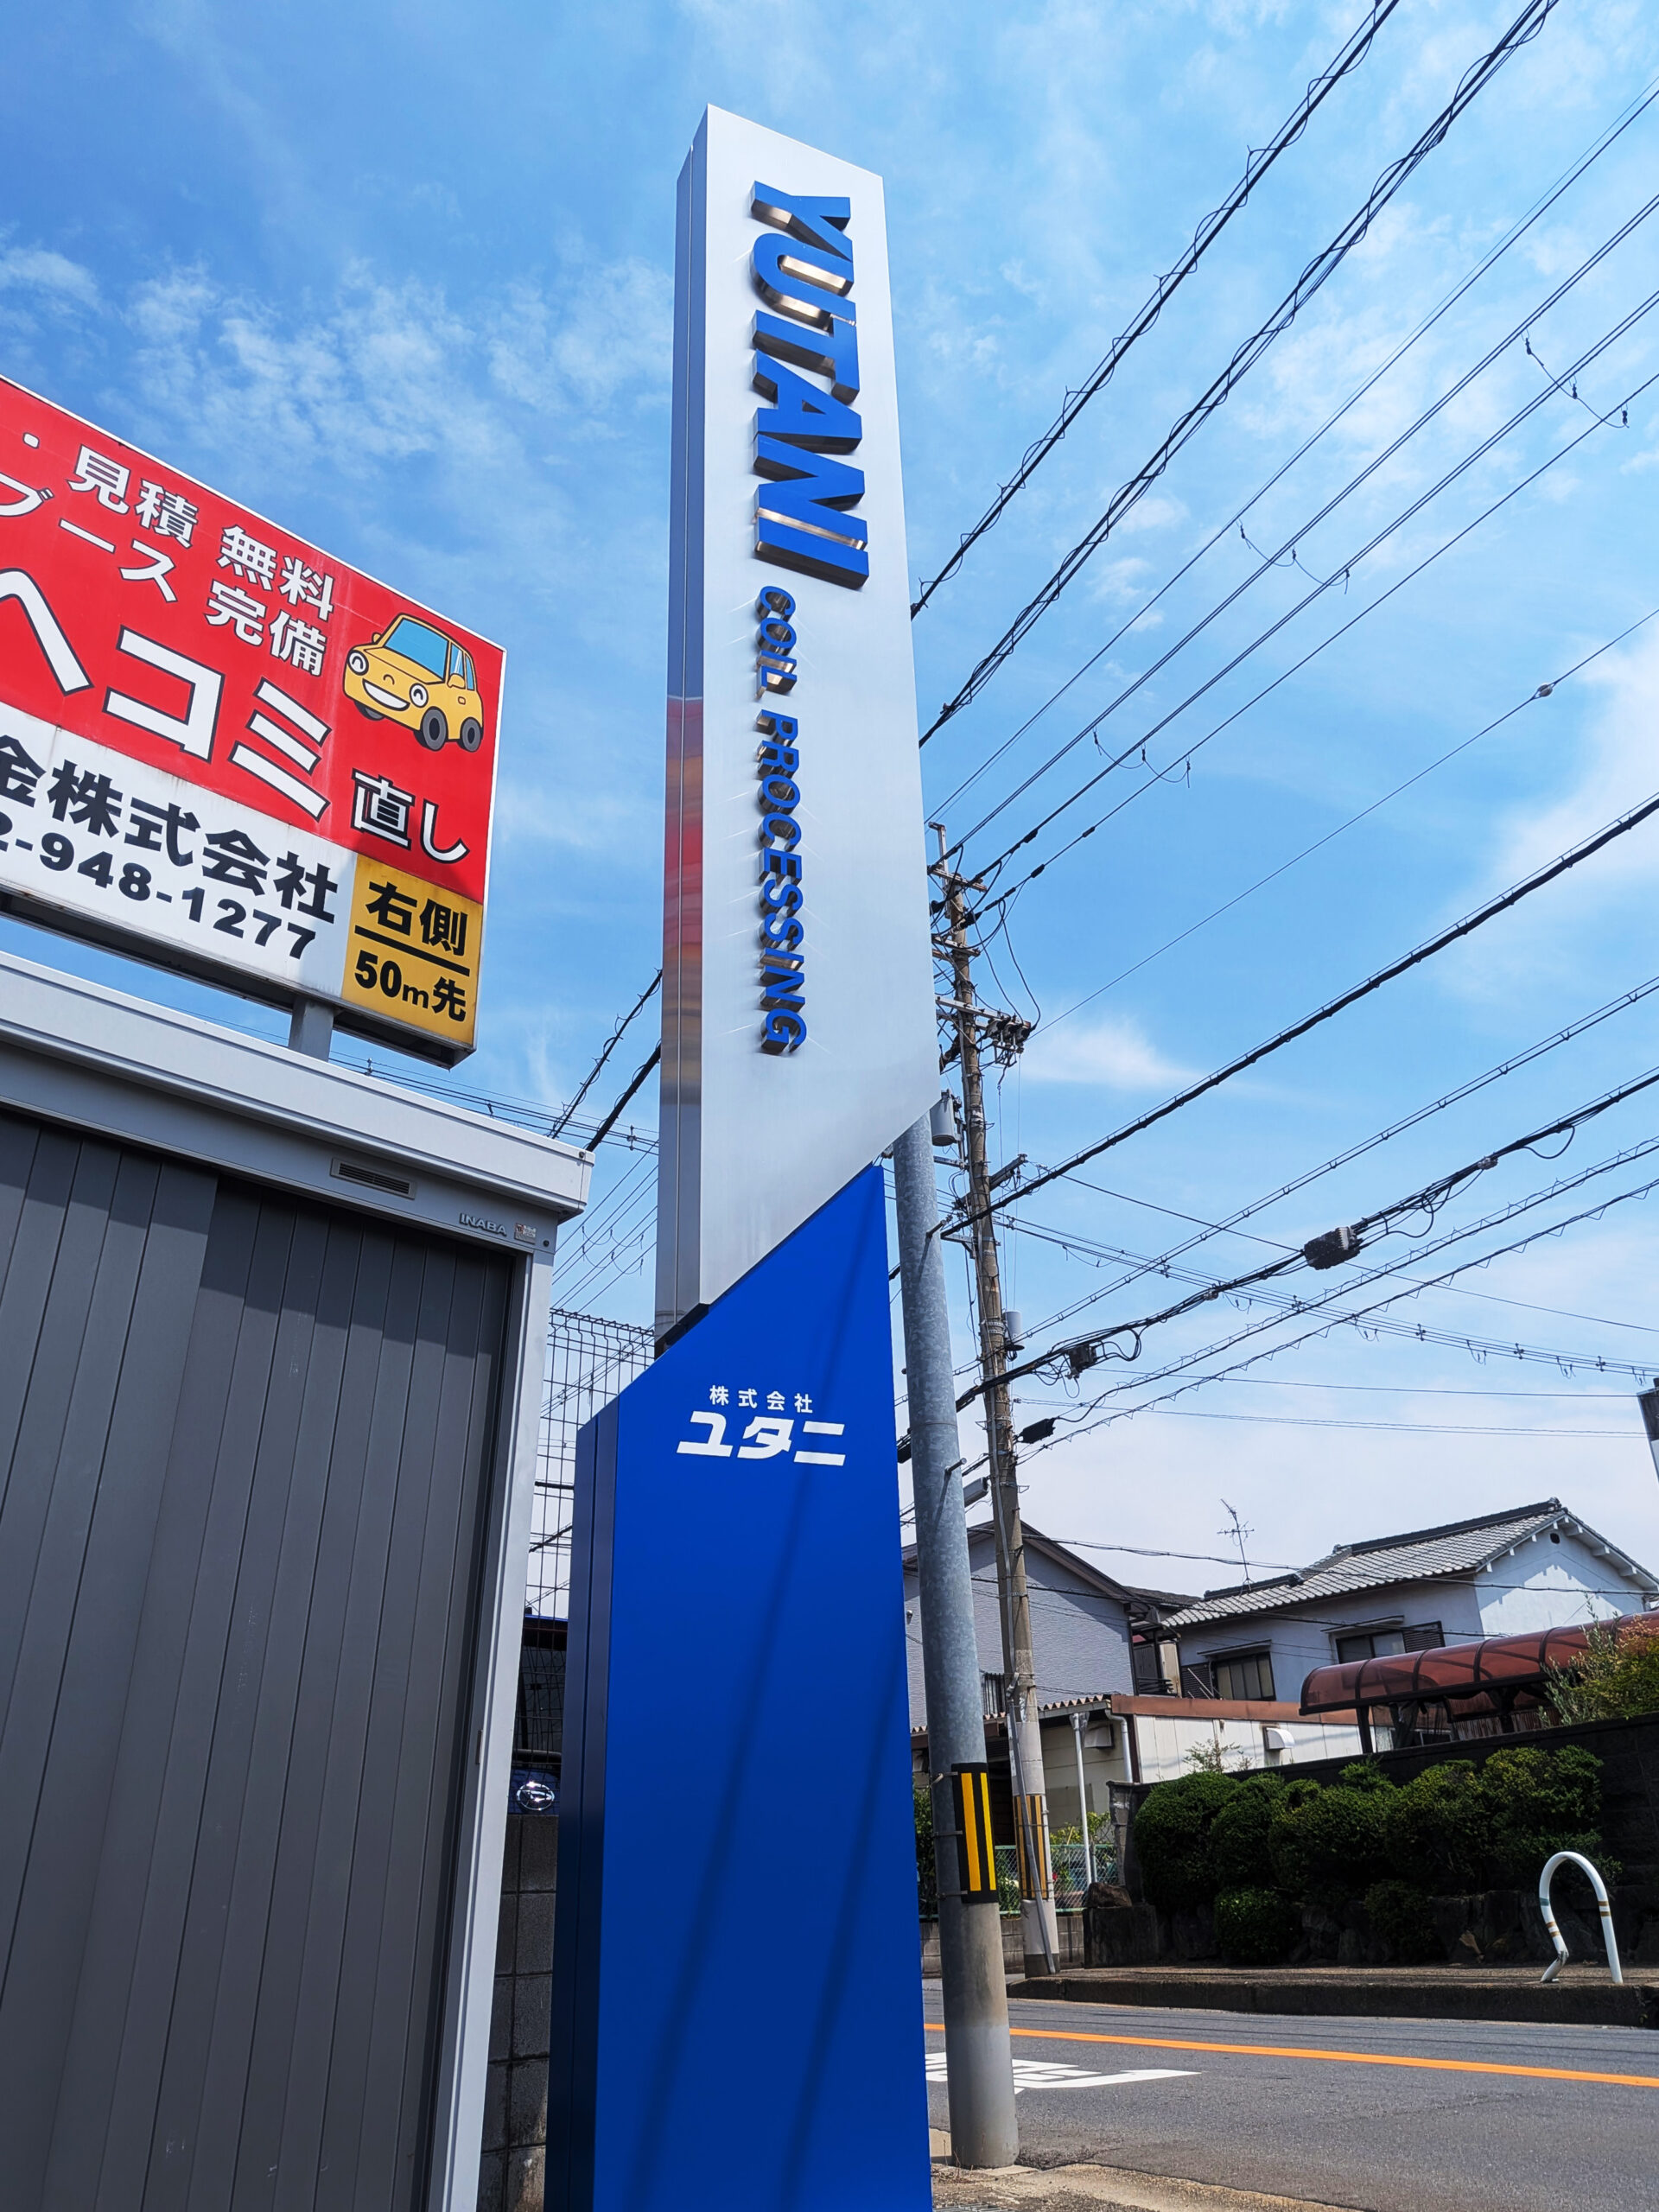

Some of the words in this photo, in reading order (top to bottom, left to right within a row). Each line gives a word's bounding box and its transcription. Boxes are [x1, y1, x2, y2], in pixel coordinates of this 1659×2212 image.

[749, 180, 869, 589] YUTANI
[756, 585, 798, 696] COIL
[365, 880, 468, 957] 右側
[757, 709, 807, 1054] PROCESSING
[354, 949, 467, 1022] 50m先
[459, 1212, 507, 1237] INABA
[709, 1384, 813, 1414] 株式会社
[677, 1410, 846, 1466] ユタニ
